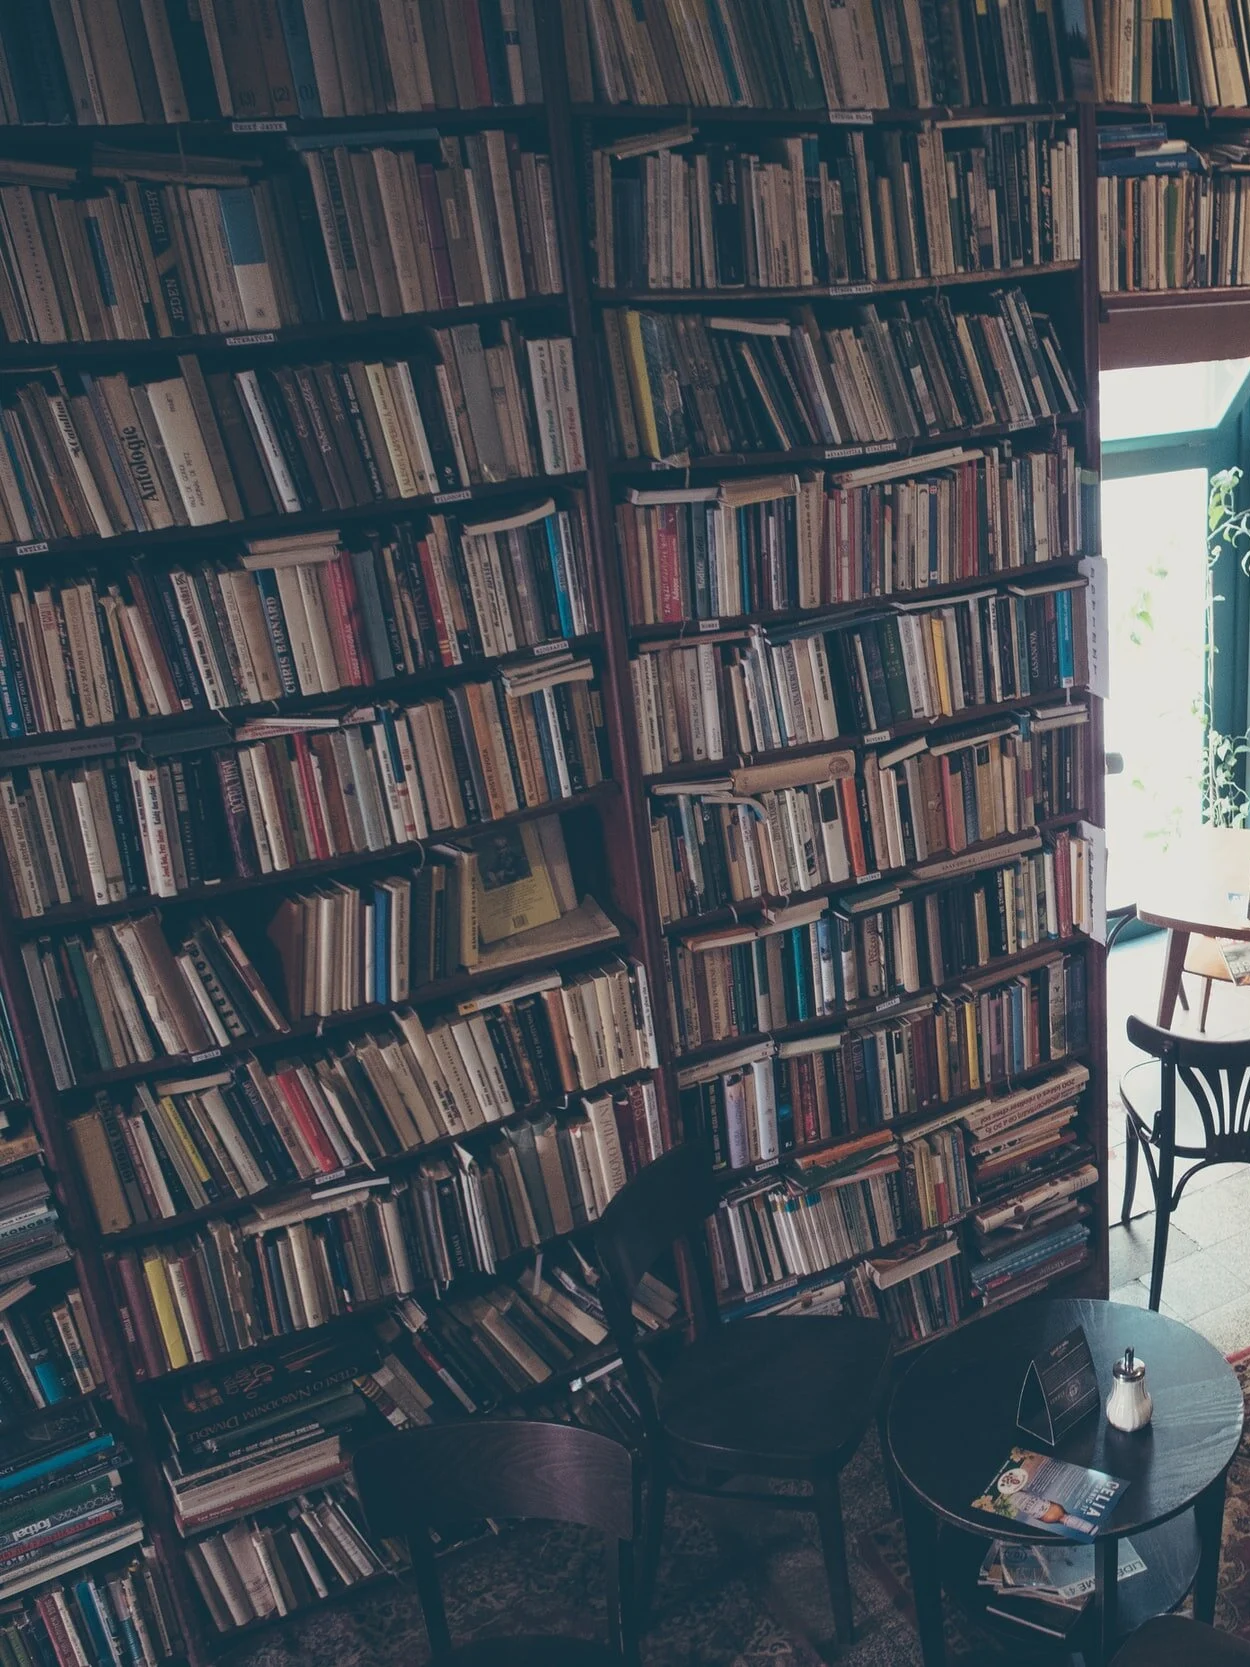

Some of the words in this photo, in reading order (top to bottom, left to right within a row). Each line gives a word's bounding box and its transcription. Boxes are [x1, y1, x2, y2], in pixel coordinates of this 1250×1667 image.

[165, 278, 186, 322] JEDEN
[545, 409, 554, 432] Freud
[121, 425, 159, 503] Antologie
[18, 543, 48, 555] ANTIKA
[266, 595, 288, 653] BARNARD
[1031, 630, 1040, 679] CASANOVA
[278, 655, 297, 694] CHRIS
[480, 747, 493, 774] ŽIVOTA
[186, 1412, 241, 1444] DIVADLE
[1085, 1479, 1121, 1519] CELIA
[12, 1517, 52, 1543] fotbal
